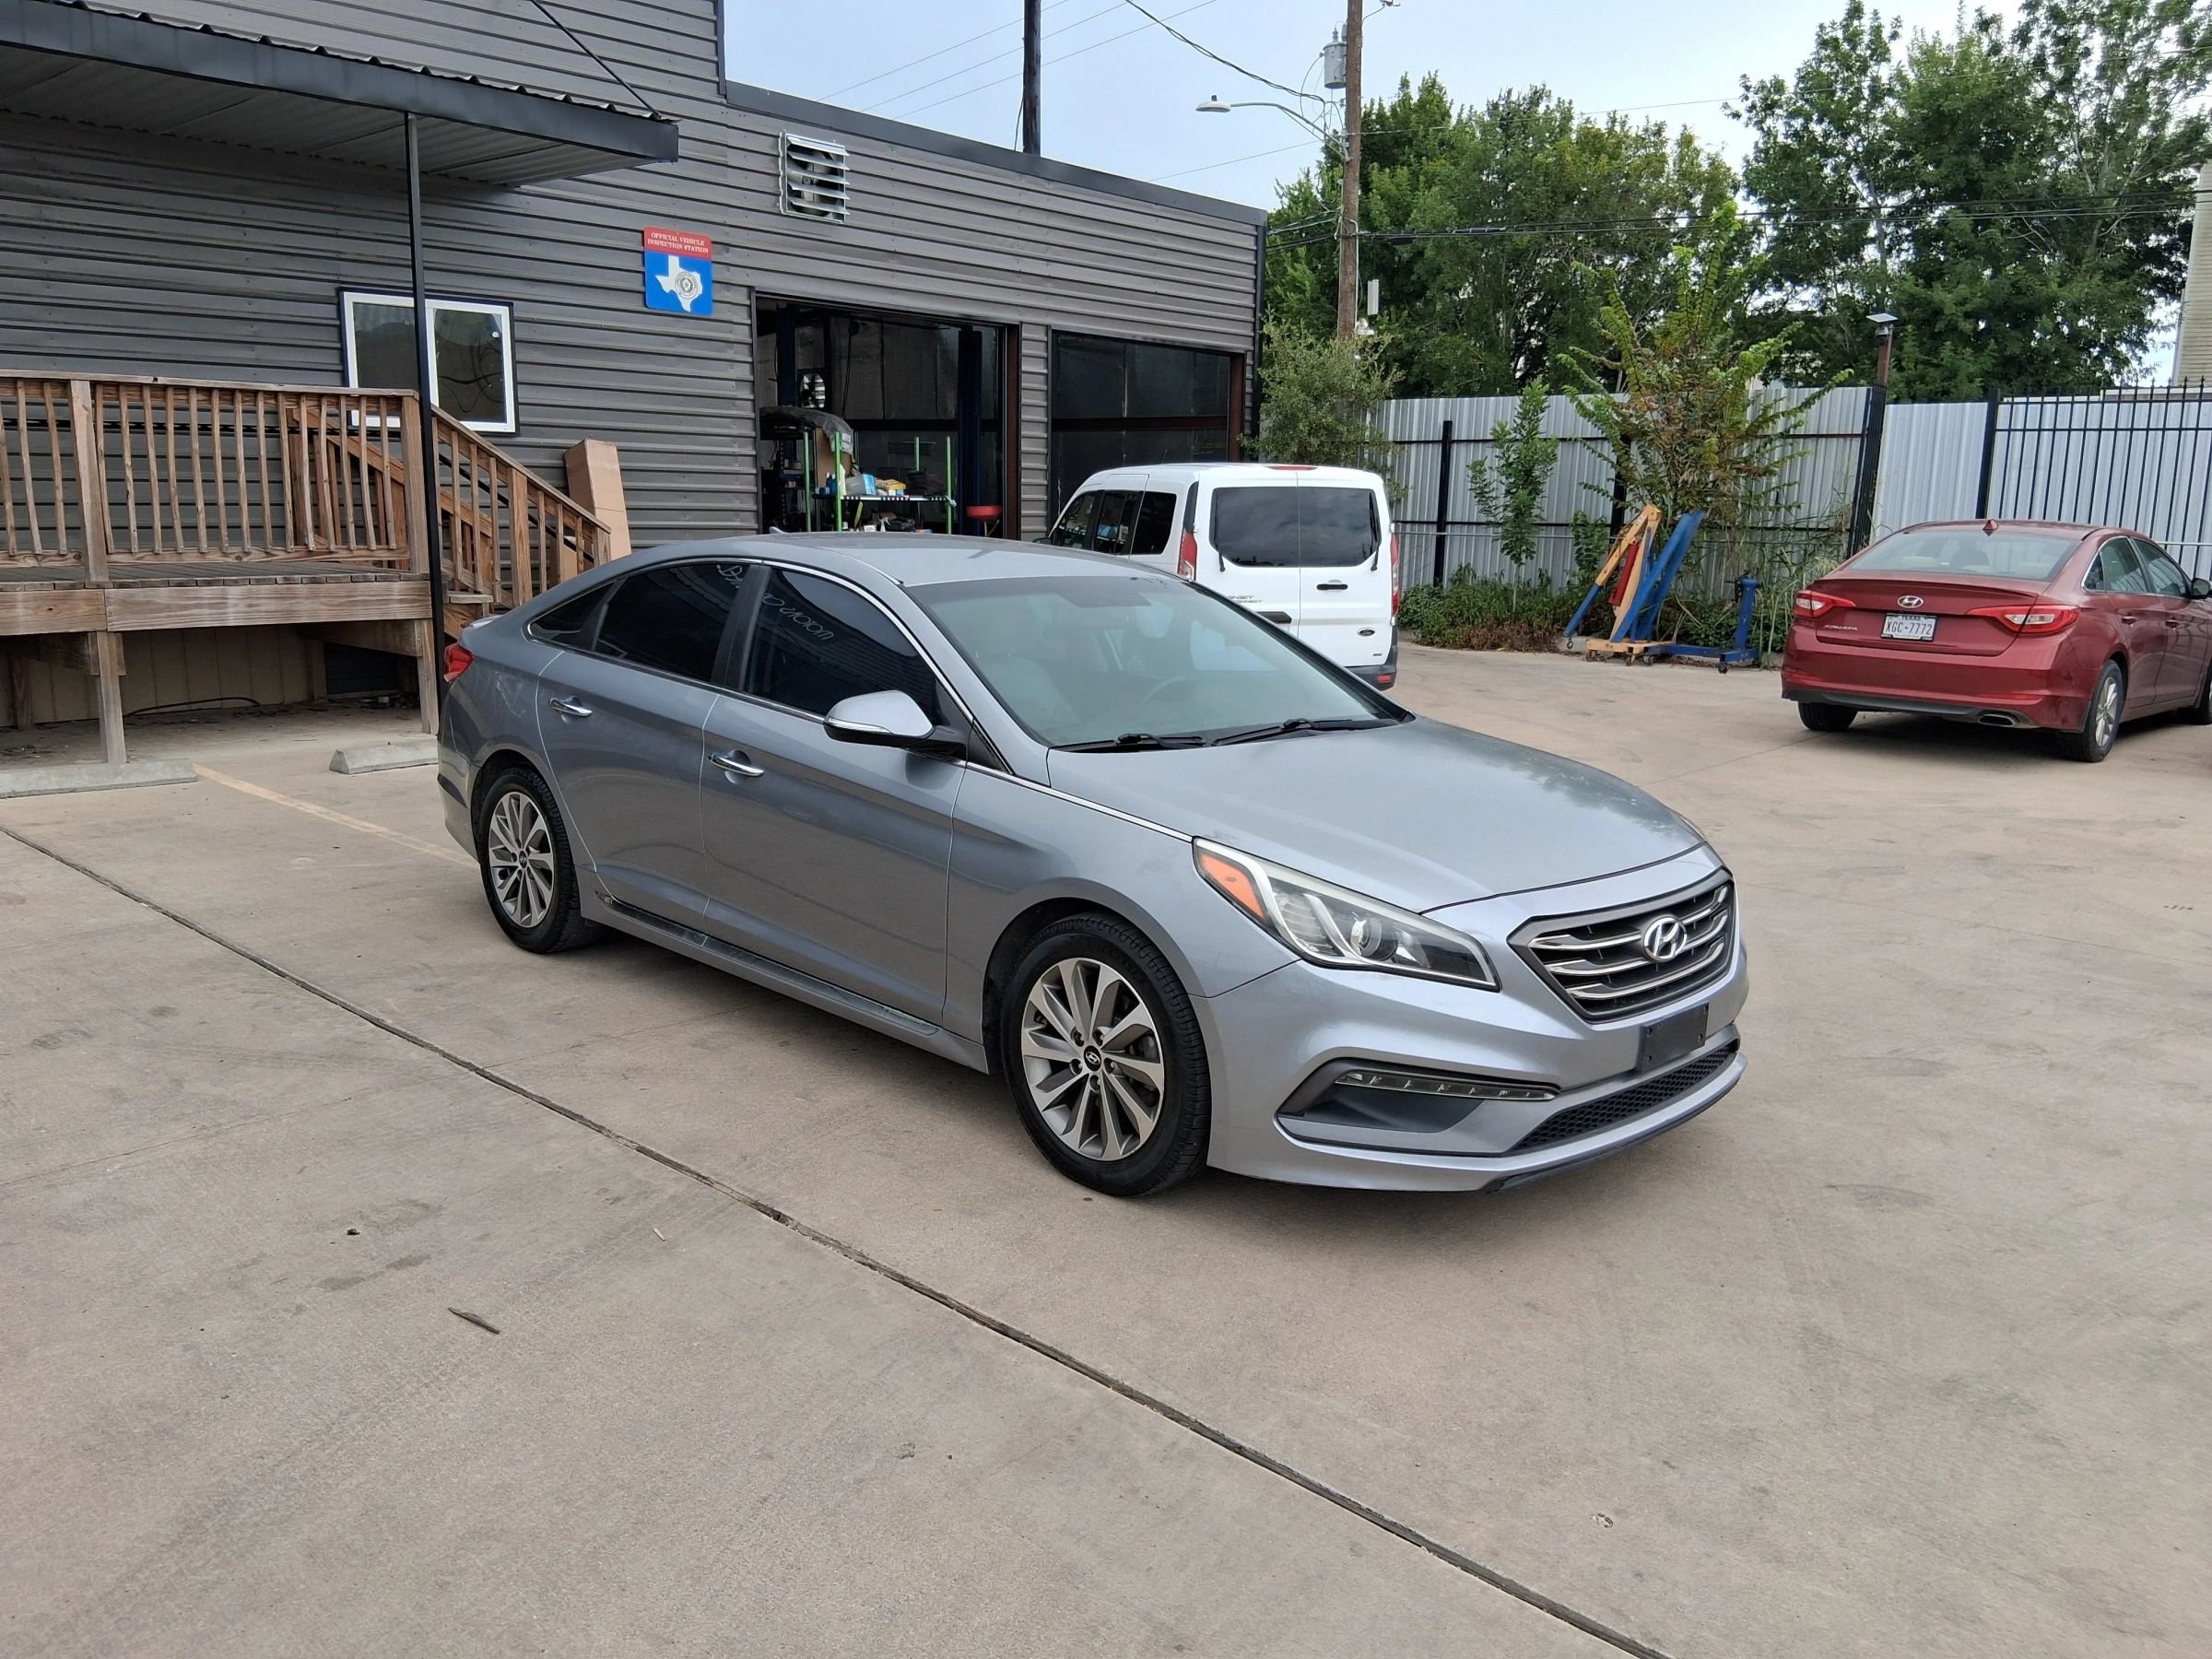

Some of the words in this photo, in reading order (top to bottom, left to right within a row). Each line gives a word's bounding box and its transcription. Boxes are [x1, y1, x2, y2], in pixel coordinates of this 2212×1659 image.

[647, 238, 683, 250] INSPECTION
[683, 244, 709, 253] STATION
[651, 232, 678, 242] OFFICIAL
[679, 236, 705, 246] VEHICLE
